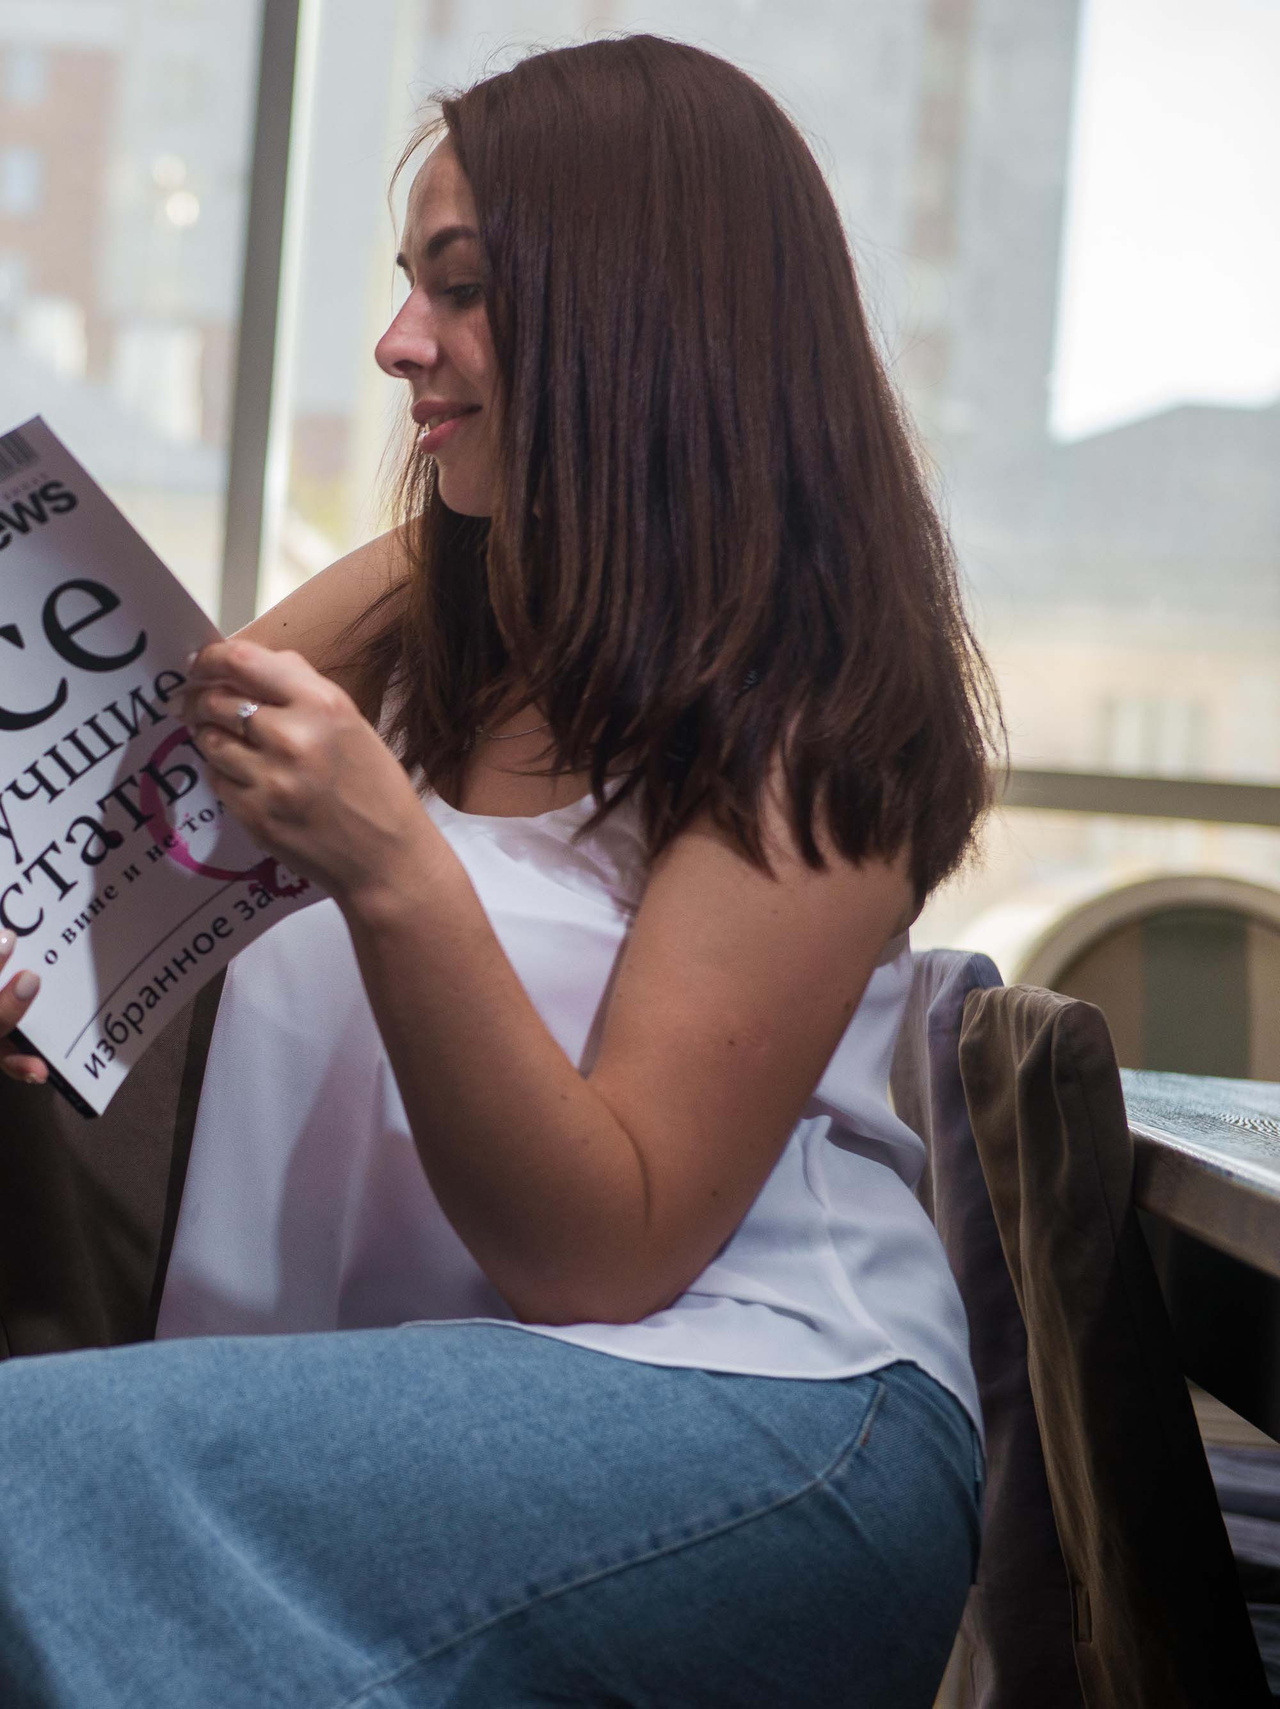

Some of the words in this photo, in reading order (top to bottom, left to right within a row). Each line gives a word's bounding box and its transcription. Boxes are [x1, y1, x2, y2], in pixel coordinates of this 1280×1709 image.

[43, 949, 59, 966] о
[61, 884, 119, 946] вине
[123, 863, 141, 884] и
[146, 834, 180, 864] не
[82, 915, 234, 1080] избранное
